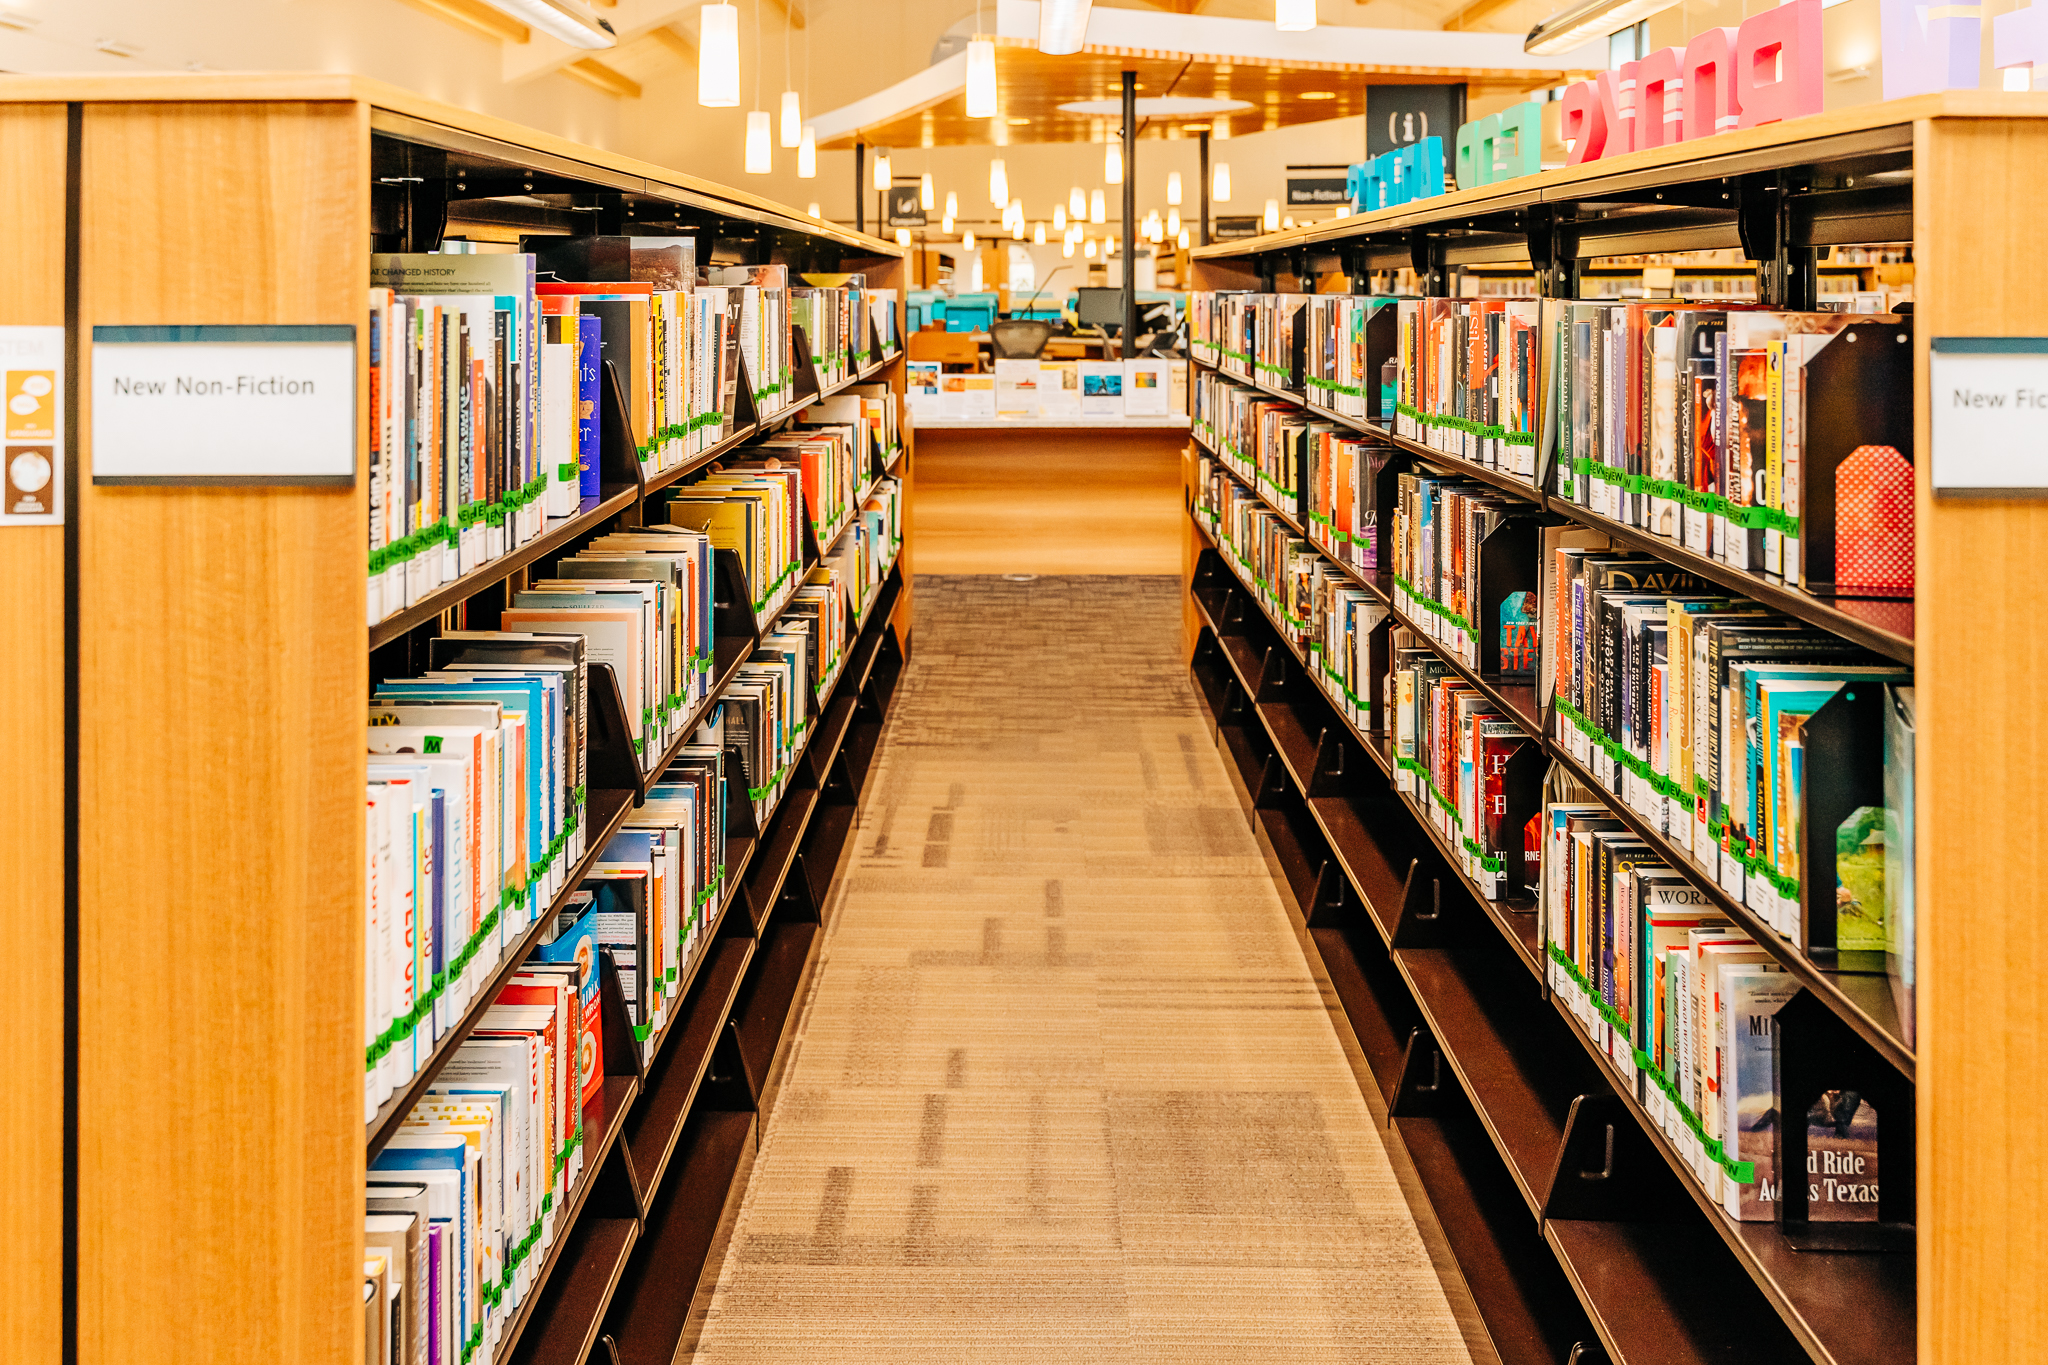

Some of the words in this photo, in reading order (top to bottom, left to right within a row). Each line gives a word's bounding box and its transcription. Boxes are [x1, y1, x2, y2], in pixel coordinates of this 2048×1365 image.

[370, 268, 380, 276] AT
[382, 268, 422, 276] CHANGED
[424, 268, 456, 276] HISTORY
[727, 304, 741, 320] AT
[1469, 316, 1479, 364] Silva
[1593, 350, 1598, 358] AT
[113, 377, 166, 396] New
[175, 375, 315, 396] Non-Fiction
[1593, 385, 1598, 393] OF
[1953, 389, 2006, 408] New
[2016, 388, 2048, 409] Fic
[1715, 430, 1720, 447] ME
[1606, 570, 1707, 592] DAVID
[1503, 624, 1538, 648] TAY
[1668, 625, 1679, 667] Summer
[1500, 648, 1537, 671] STE
[1575, 650, 1581, 672] WE
[1709, 640, 1718, 660] THE
[1429, 665, 1453, 675] MICH
[1669, 669, 1675, 682] on
[1709, 664, 1718, 699] STARS
[1668, 689, 1679, 704] the
[1669, 707, 1679, 733] River
[1709, 702, 1718, 726] NOW
[1709, 729, 1718, 792] UNCLAIMED
[1524, 850, 1541, 862] RNE
[1748, 1014, 1769, 1036] MI
[1822, 1150, 1865, 1175] Ride
[1822, 1178, 1879, 1203] Texas
